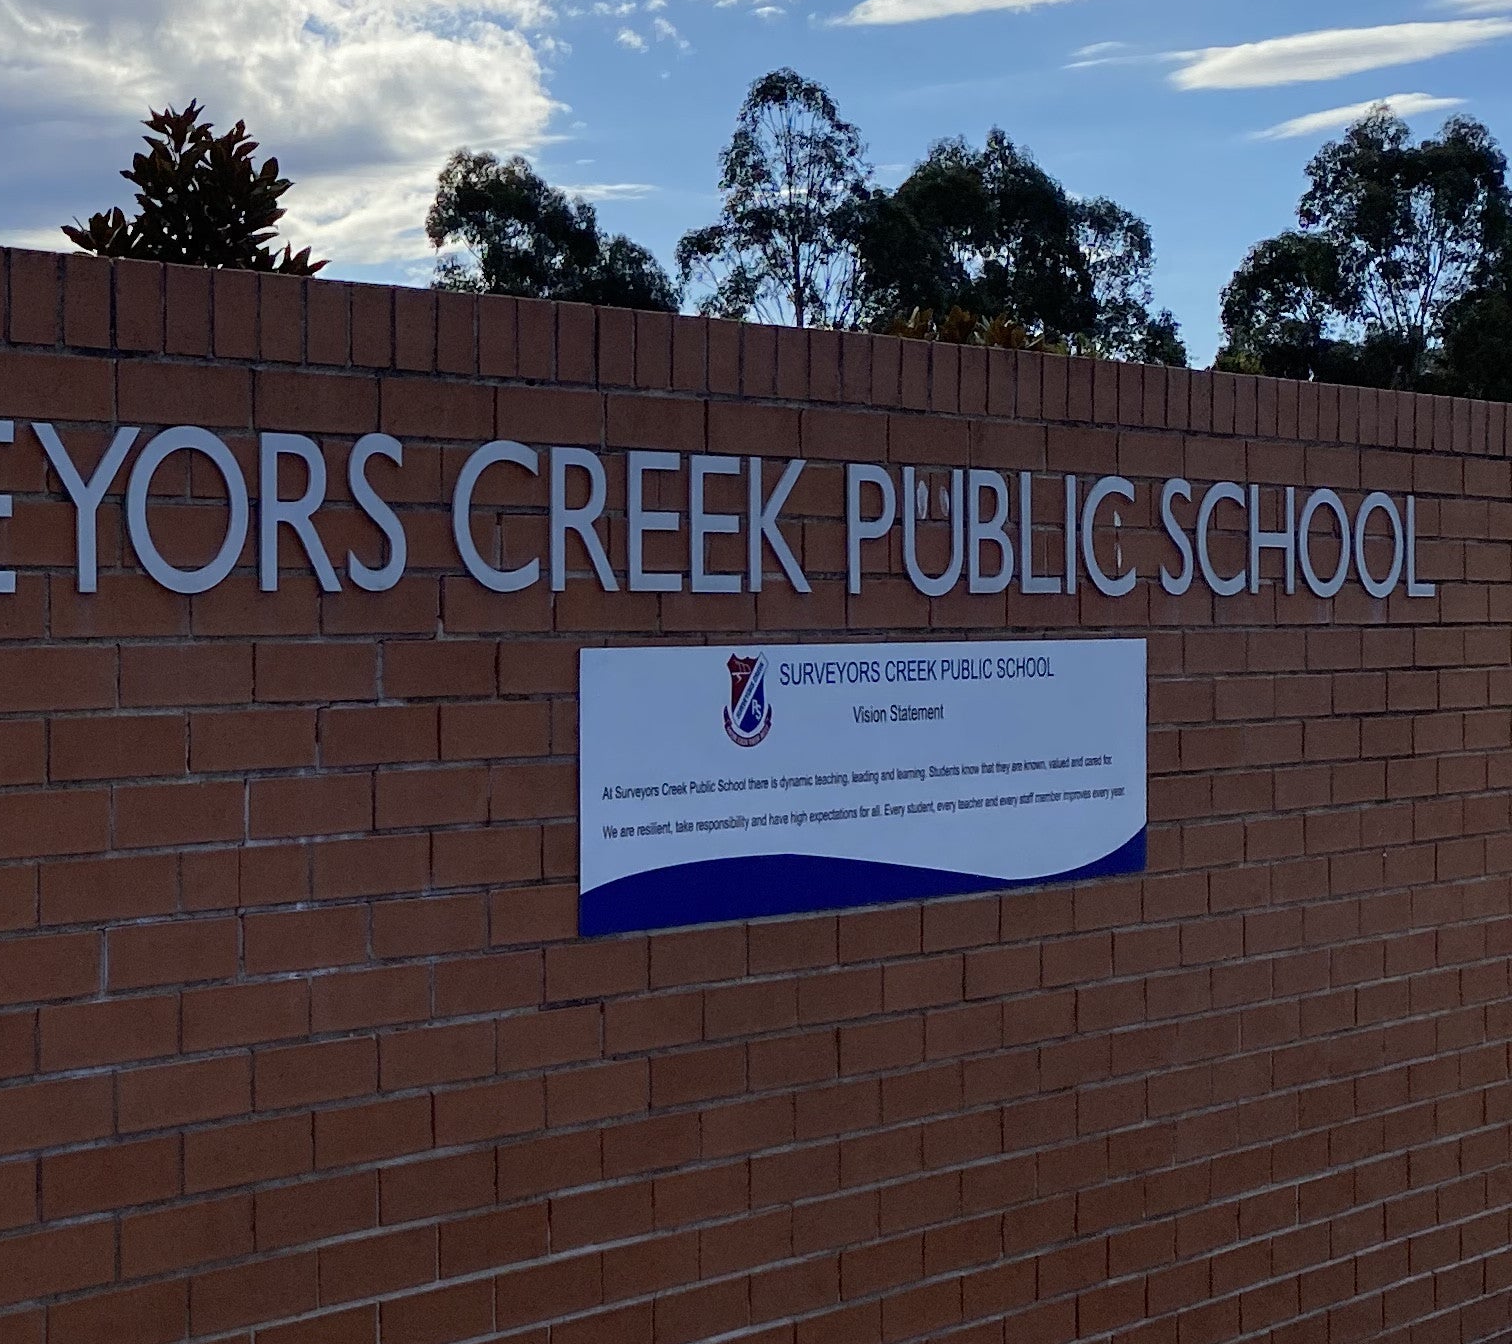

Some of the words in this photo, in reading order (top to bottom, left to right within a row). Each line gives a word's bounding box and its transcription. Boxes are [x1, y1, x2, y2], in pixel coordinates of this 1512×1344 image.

[452, 440, 811, 595] CREEK
[846, 462, 1137, 597] PUBLIC
[1160, 477, 1436, 598] SCHOOL
[779, 661, 881, 686] SURVEYORS
[885, 659, 937, 683] CREEK
[941, 658, 992, 681] PUBLIC
[996, 656, 1055, 679] SCHOOL
[853, 705, 887, 724] Vision
[890, 704, 944, 722] Statement
[615, 786, 659, 801] Surveyors
[662, 783, 687, 797] Creek
[690, 780, 716, 795] Public
[718, 777, 746, 792] School
[748, 777, 769, 790] there
[771, 776, 778, 789] is
[779, 774, 813, 791] dynamic
[851, 770, 878, 784] leading
[881, 768, 894, 781] and
[929, 764, 960, 778] Students
[962, 763, 979, 775] know
[602, 825, 618, 839] We
[620, 825, 635, 838] are
[675, 820, 694, 833] take
[696, 815, 749, 834] responsibility
[751, 813, 767, 827] and
[769, 813, 789, 826] have
[790, 811, 808, 827] high
[809, 808, 858, 824] expectations
[859, 805, 870, 818] for
[884, 803, 906, 817] Every
[937, 800, 956, 813] every
